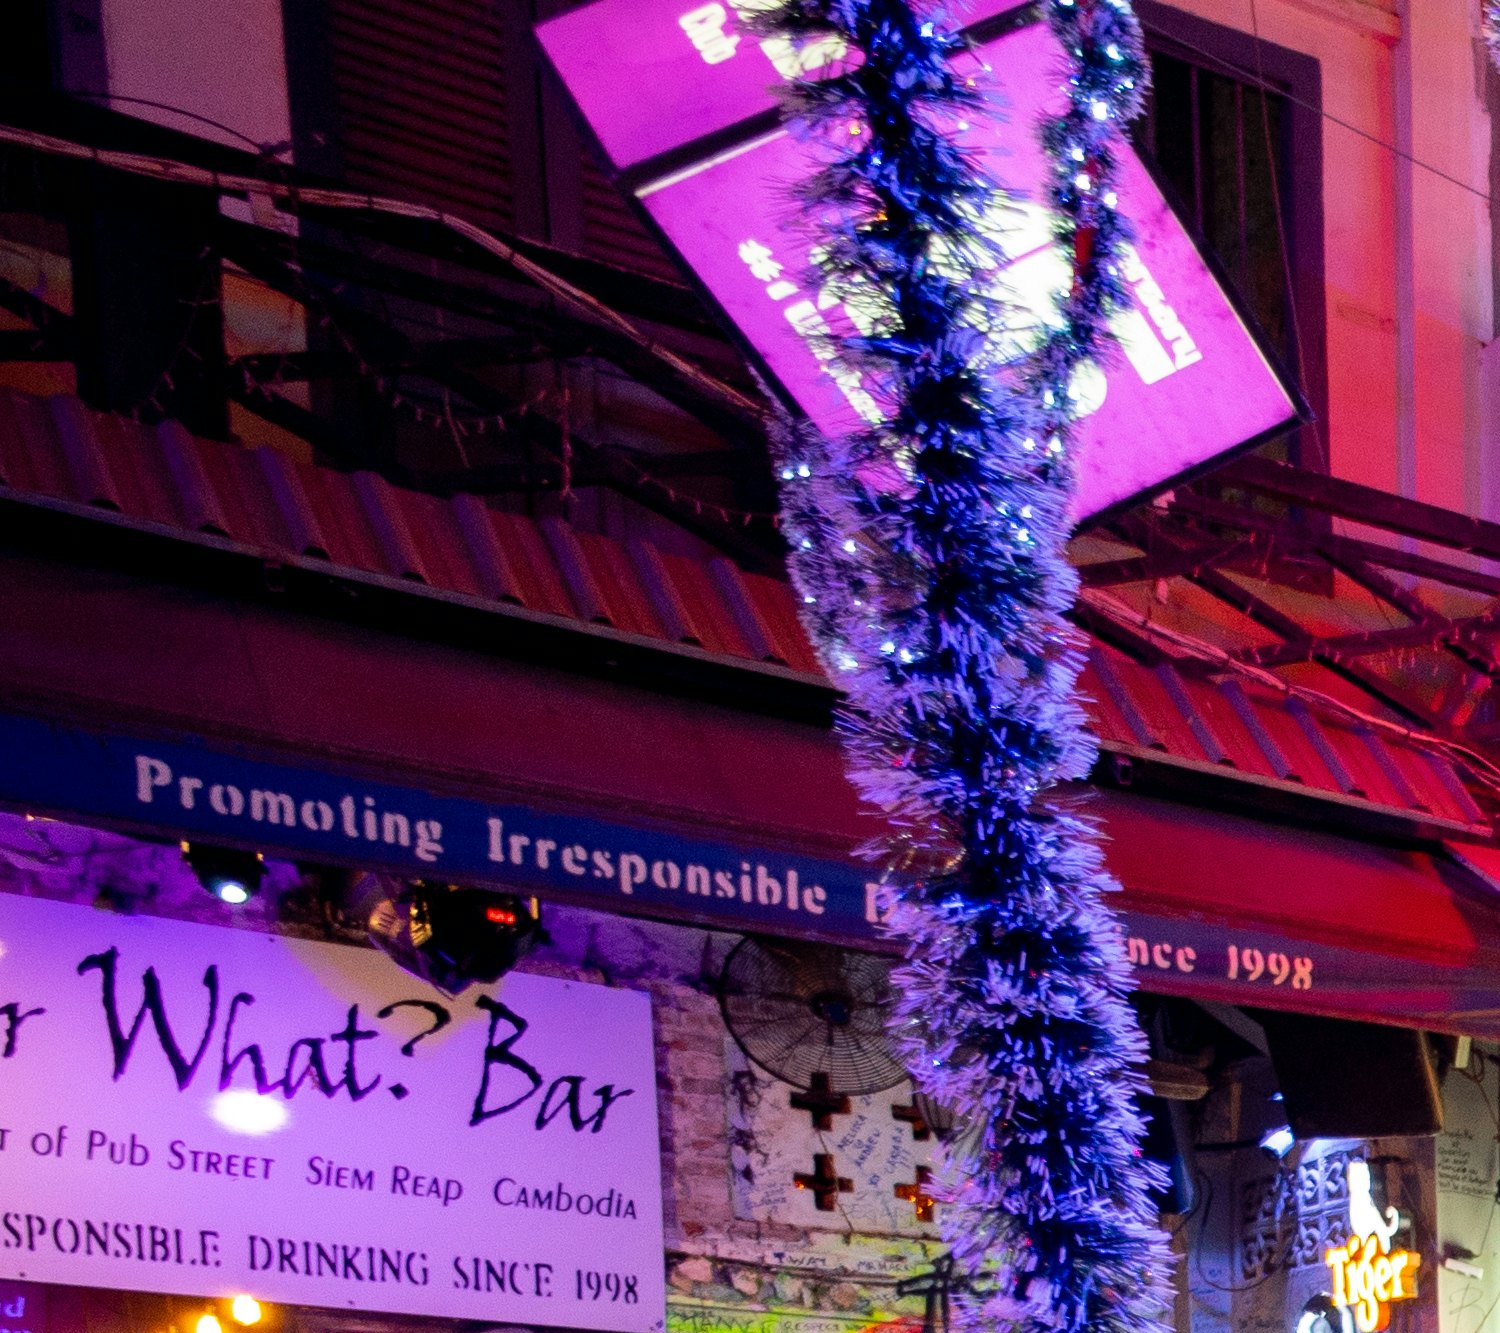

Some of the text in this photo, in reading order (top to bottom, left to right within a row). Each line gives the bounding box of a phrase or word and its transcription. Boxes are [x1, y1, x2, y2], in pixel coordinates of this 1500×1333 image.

[134, 755, 827, 915] Promoting Irresponsible
[1227, 944, 1313, 991] 1998
[77, 946, 451, 1102] What?
[469, 995, 635, 1133] Bar
[31, 1126, 69, 1158] of
[87, 1128, 149, 1168] Pub
[249, 1234, 429, 1286] DRINKING
[453, 1257, 554, 1299] SINCE
[575, 1268, 639, 1304] 1998
[1325, 1234, 1410, 1333] Tiger
